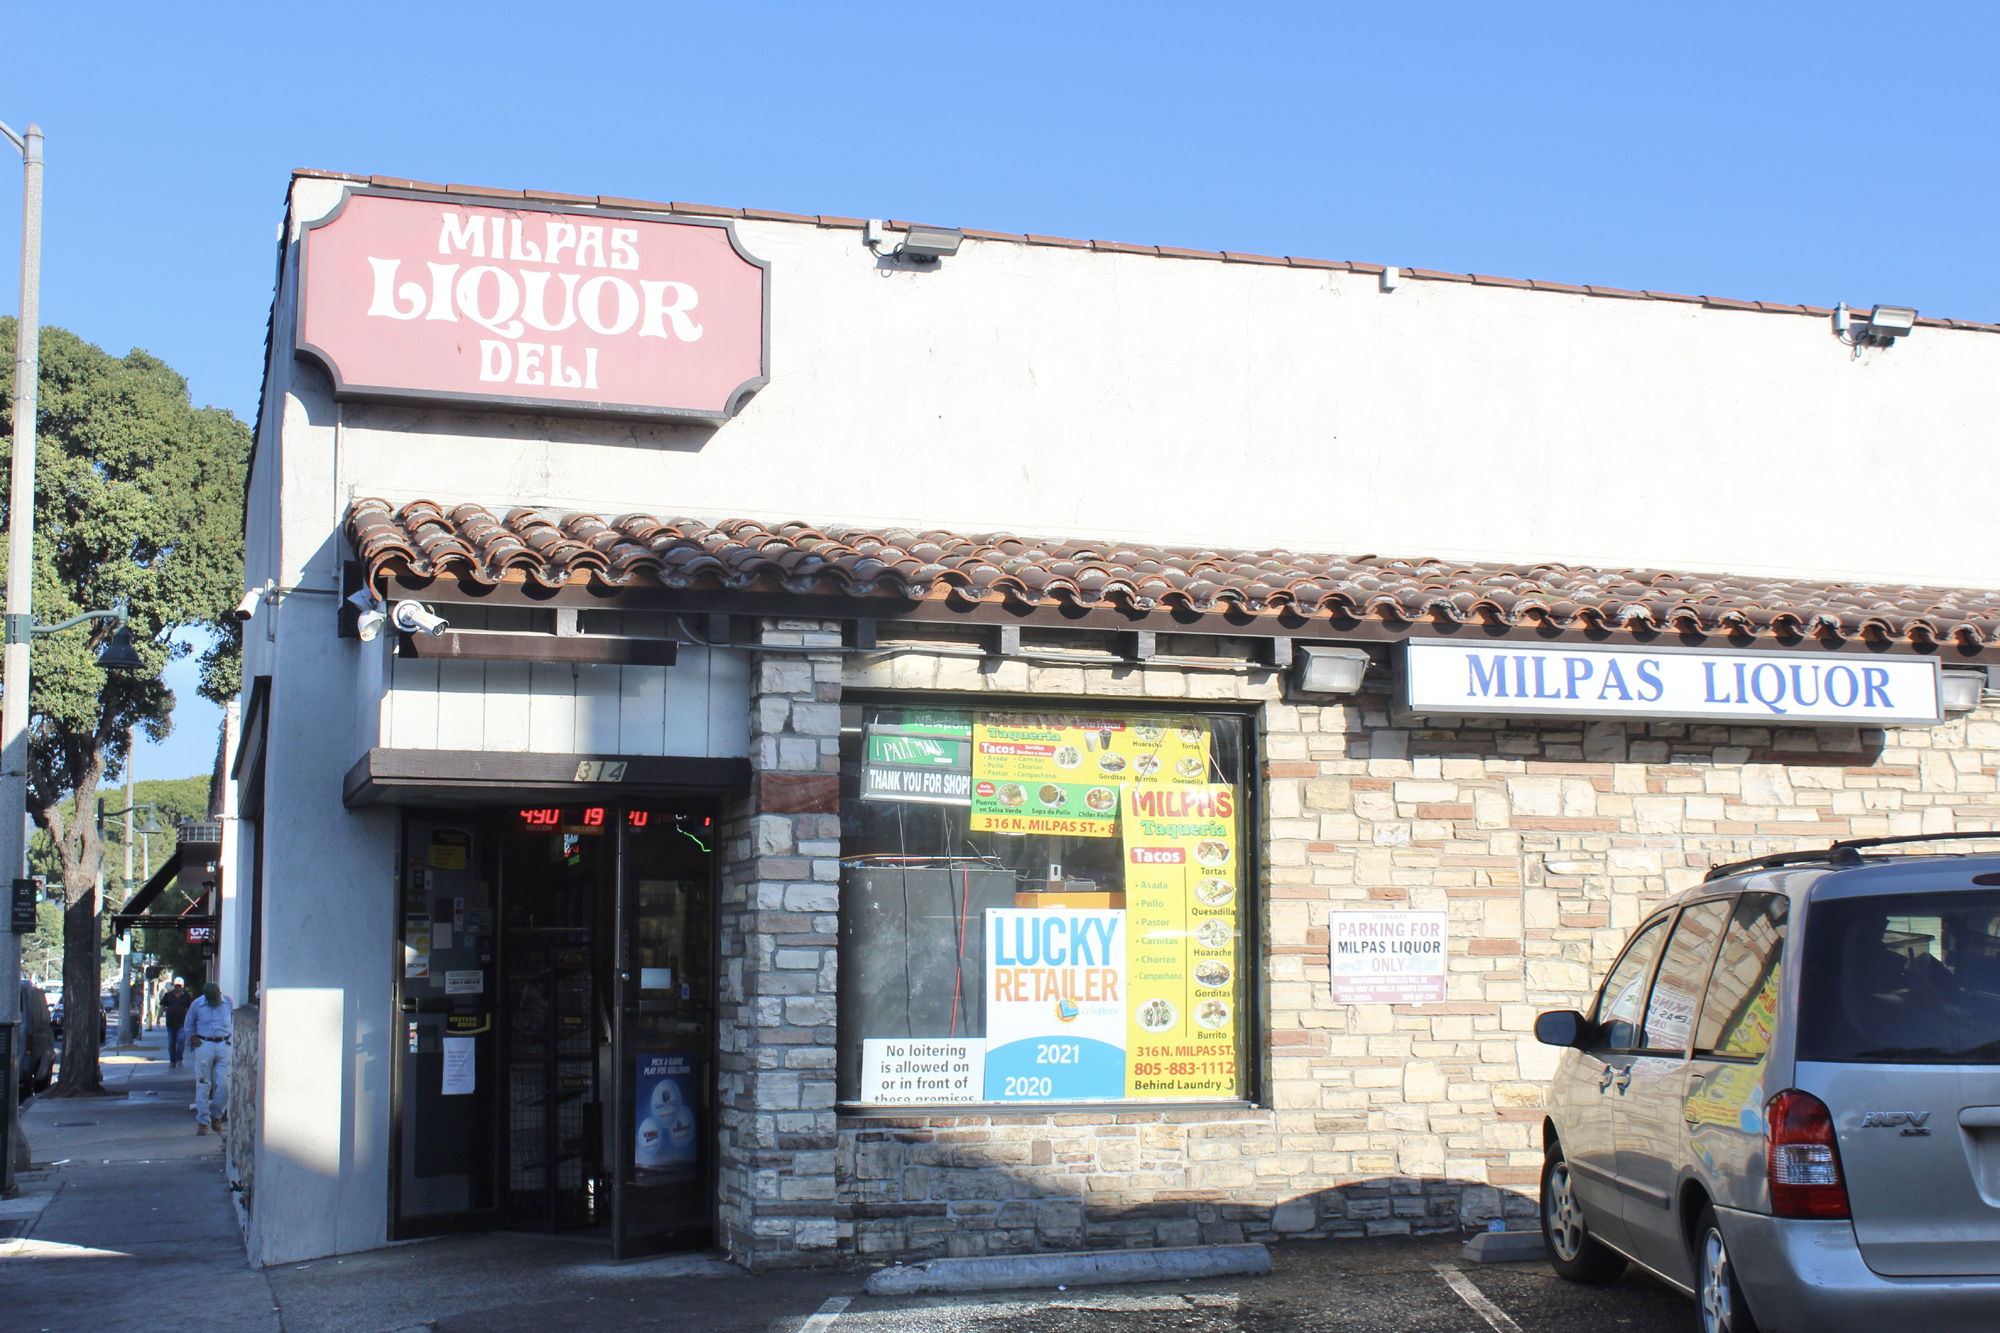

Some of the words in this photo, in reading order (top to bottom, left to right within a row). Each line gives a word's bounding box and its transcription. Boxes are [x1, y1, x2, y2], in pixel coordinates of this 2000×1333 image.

[438, 213, 640, 271] MILPAS
[367, 256, 704, 343] LIQUOR
[479, 339, 598, 390] DELI
[1466, 654, 1664, 702] MILPAS
[1704, 661, 1895, 714] LIQUOR
[914, 714, 969, 731] Newport
[980, 711, 1068, 731] MILPAS
[981, 742, 1015, 754] Tacos
[577, 762, 625, 782] 314
[1017, 771, 1056, 779] Campechano
[1099, 773, 1126, 781] Gorditas
[869, 769, 901, 791] THANK
[903, 771, 922, 792] YOU
[923, 772, 942, 793] FOR
[1132, 790, 1233, 818] MILPAS
[520, 809, 560, 824] 490
[584, 807, 605, 825] 19
[526, 824, 553, 832] MILLION
[984, 817, 1009, 829] 316
[1011, 819, 1026, 830] N.
[1028, 820, 1077, 832] MILPAS
[1079, 822, 1097, 833] ST.
[1133, 848, 1180, 863] Tacos
[1200, 867, 1227, 875] Tortas
[1140, 881, 1168, 890] Asada
[1141, 899, 1164, 908] Pollo
[1191, 907, 1235, 916] Quesadilla
[1141, 918, 1170, 926] Pastor
[1338, 922, 1405, 937] PARKING
[1410, 922, 1440, 937] FOR
[995, 916, 1119, 967] LUCKY
[1141, 936, 1179, 945] Carnitas
[1193, 948, 1232, 957] Huarache
[1338, 941, 1386, 954] MILPAS
[1391, 941, 1441, 955] LIQUOR
[1141, 955, 1176, 964] Chorizo
[1371, 958, 1405, 972] ONLY
[1138, 971, 1182, 982] Campechano
[995, 968, 1119, 1002] RETAILER
[1195, 989, 1231, 998] Gorditas
[1197, 1031, 1227, 1039] Burrito
[886, 1045, 905, 1057] No
[909, 1044, 966, 1059] loitering
[1036, 1044, 1080, 1064] 2021
[1136, 1046, 1159, 1057] 316
[1161, 1046, 1173, 1057] N.
[1175, 1045, 1217, 1057] MILPAS
[1218, 1045, 1235, 1056] ST.
[651, 1058, 664, 1066] PICK
[881, 1061, 891, 1073] is
[895, 1060, 949, 1073] allowed
[953, 1063, 970, 1072] on
[643, 1067, 656, 1076] PLAY
[656, 1066, 667, 1075] FOR
[881, 1080, 896, 1090] or
[900, 1077, 912, 1089] in
[916, 1076, 950, 1089] front
[954, 1076, 969, 1089] of
[1004, 1076, 1052, 1096] 2020
[1134, 1080, 1175, 1090] Behind
[1177, 1079, 1222, 1091] Laundry
[1861, 1111, 1931, 1128] MPV
